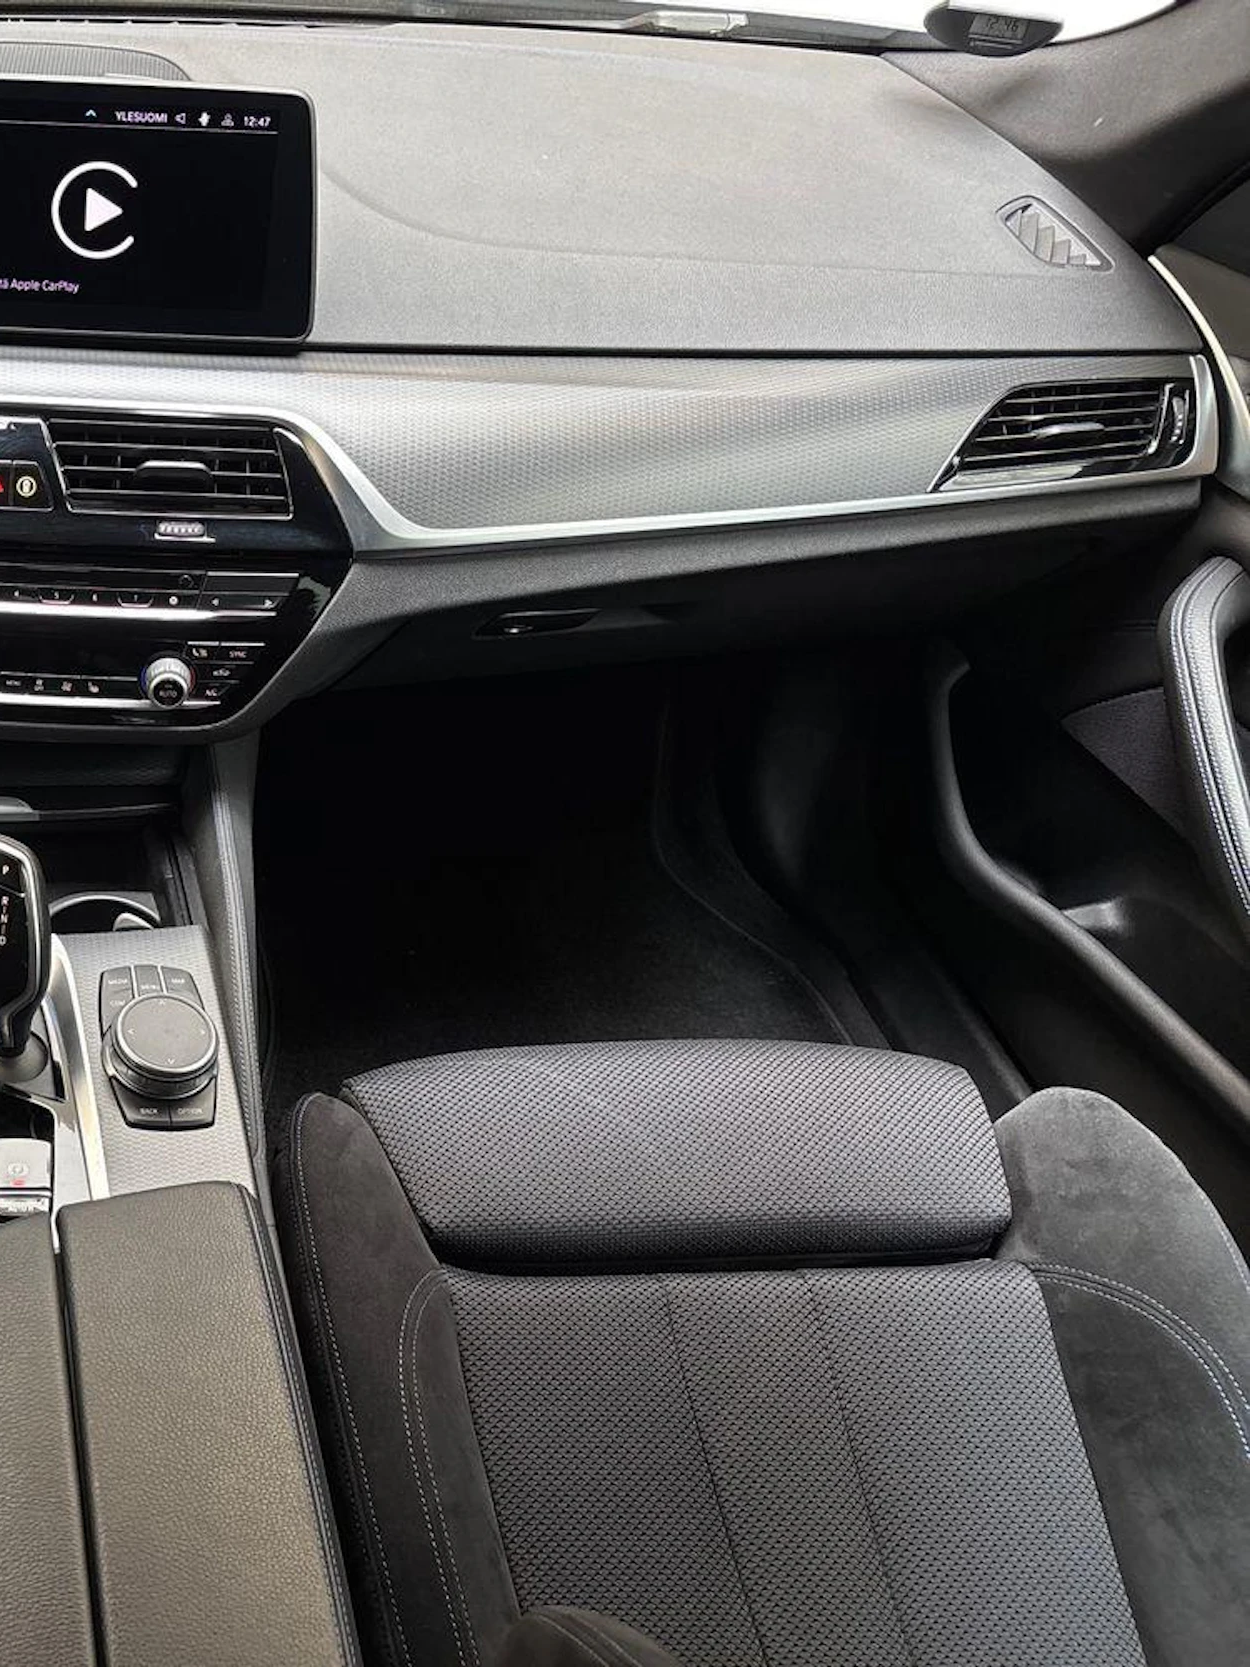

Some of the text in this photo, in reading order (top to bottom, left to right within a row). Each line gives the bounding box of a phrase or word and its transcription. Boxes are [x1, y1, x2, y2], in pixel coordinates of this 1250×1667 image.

[115, 111, 168, 123] YLESUOMI
[244, 116, 271, 128] 12:47
[10, 278, 40, 291] Apple
[41, 280, 80, 294] CarPlay
[1, 864, 10, 875] P
[1, 895, 10, 906] R
